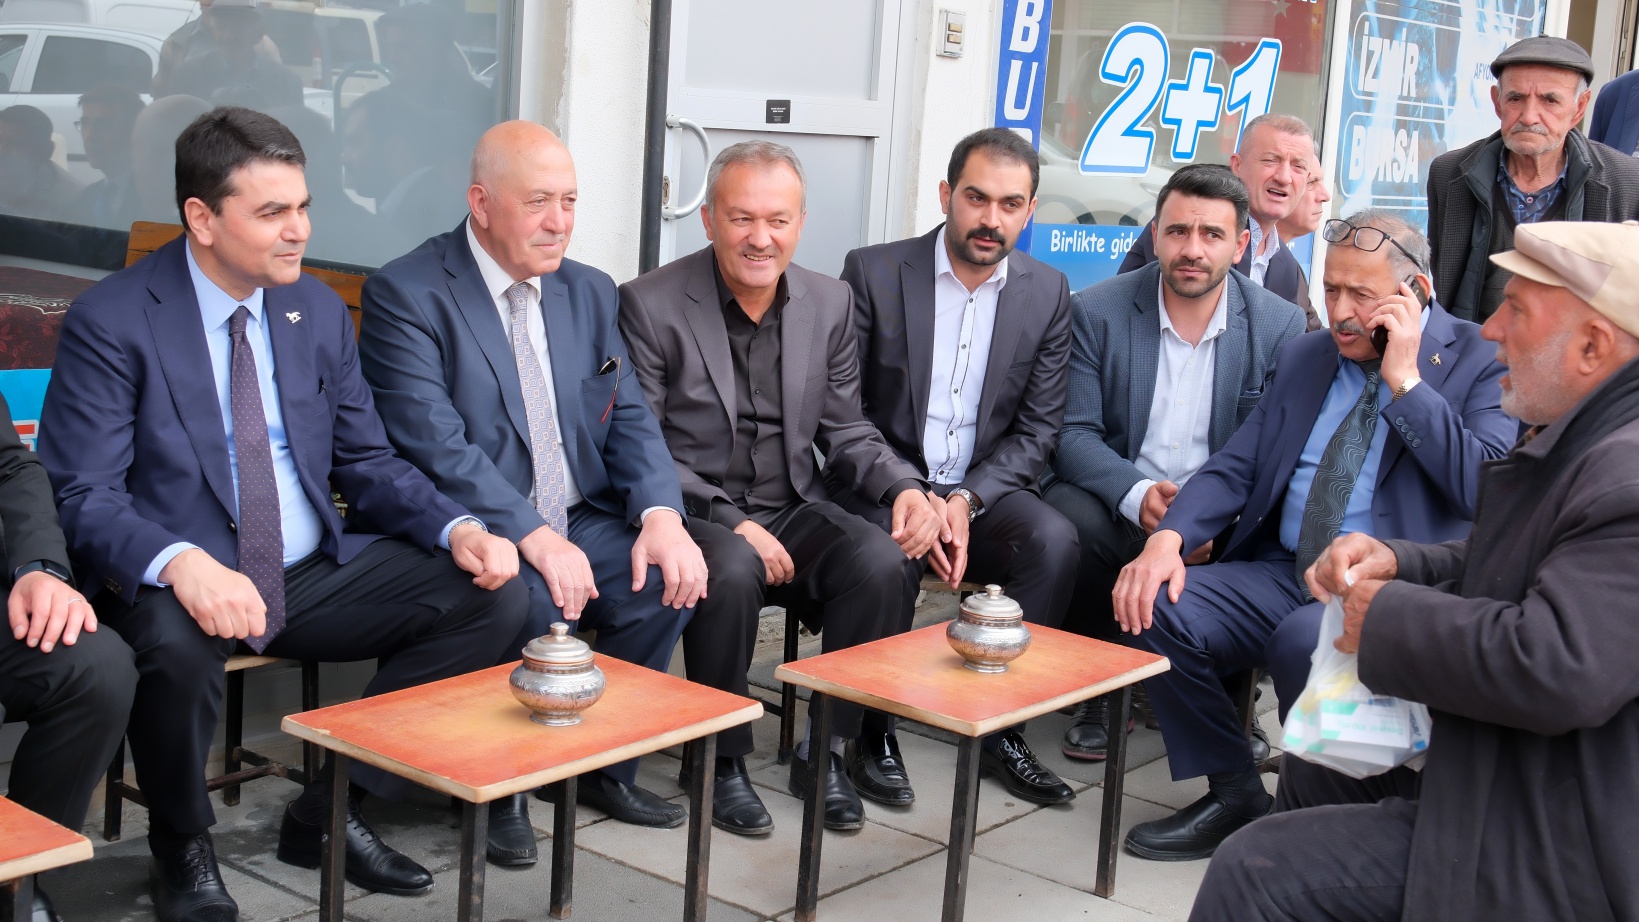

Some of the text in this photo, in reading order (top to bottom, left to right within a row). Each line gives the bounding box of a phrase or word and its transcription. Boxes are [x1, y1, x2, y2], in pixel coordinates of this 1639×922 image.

[1003, 0, 1044, 146] BU
[1358, 21, 1419, 97] İZMİR
[1079, 21, 1282, 176] 2+1
[1349, 125, 1419, 184] BURSA
[1050, 229, 1137, 260] Birlikte gid
